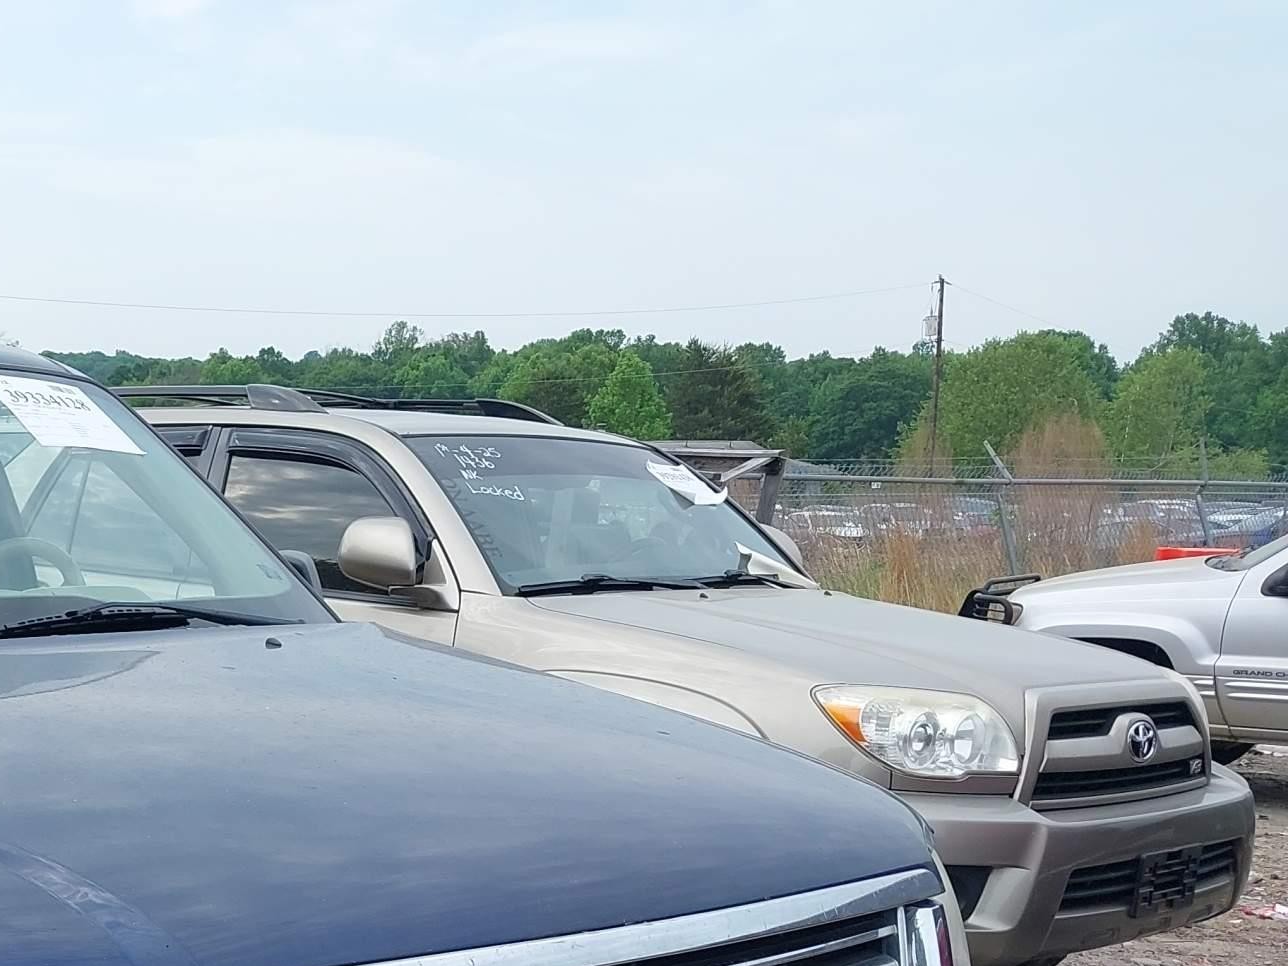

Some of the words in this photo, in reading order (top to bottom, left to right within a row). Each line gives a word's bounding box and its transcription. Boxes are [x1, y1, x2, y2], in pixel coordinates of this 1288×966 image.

[3, 389, 91, 412] 39334128
[465, 481, 525, 501] Locked
[1232, 669, 1273, 677] GRAND
